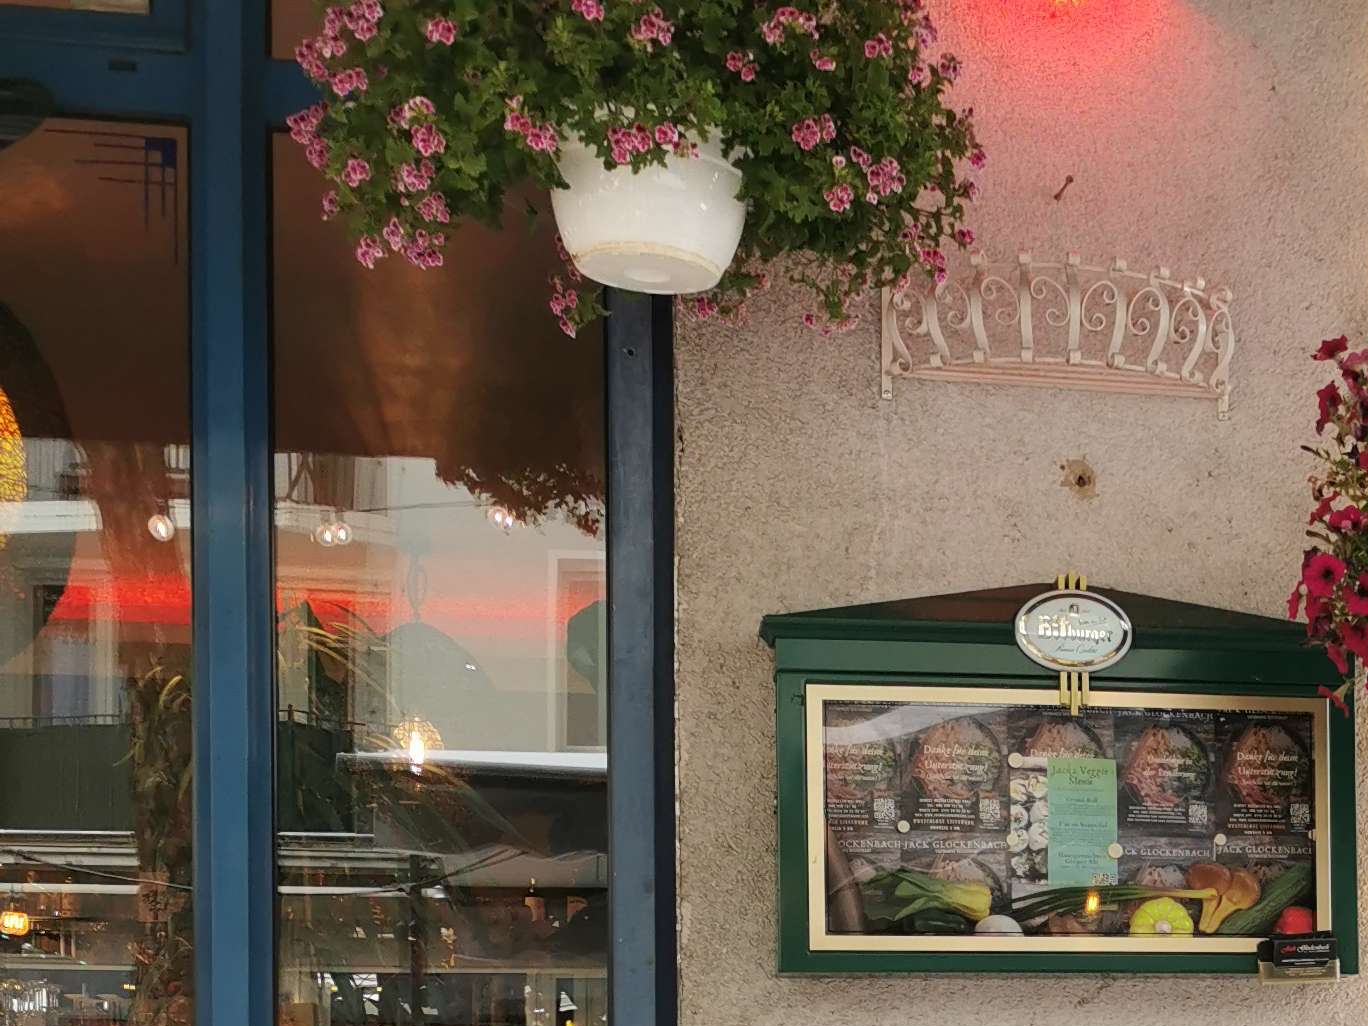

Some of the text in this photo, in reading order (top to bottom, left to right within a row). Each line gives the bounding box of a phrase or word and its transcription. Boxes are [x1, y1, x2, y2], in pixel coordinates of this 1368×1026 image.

[904, 841, 1008, 850] JACK GLOCKENBACH
[1216, 845, 1243, 855] JACK
[1140, 848, 1210, 858] GLOCKENBACH
